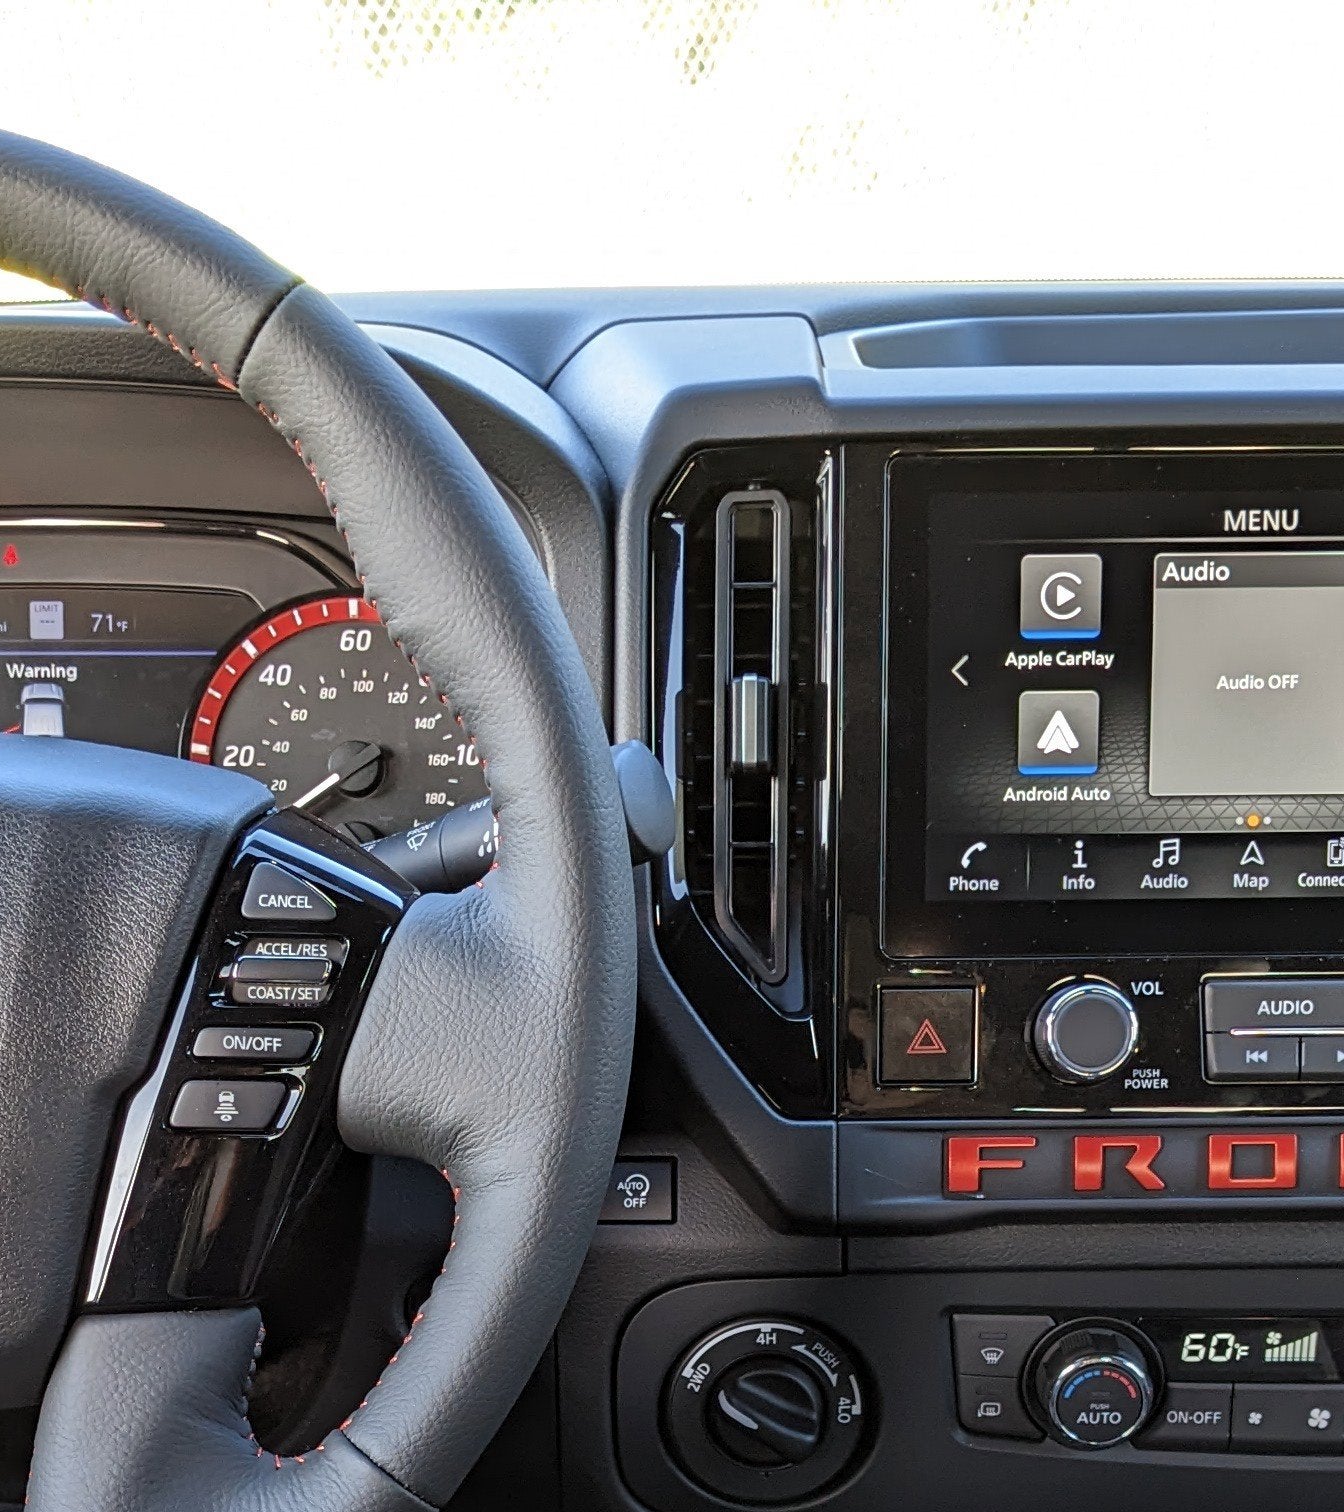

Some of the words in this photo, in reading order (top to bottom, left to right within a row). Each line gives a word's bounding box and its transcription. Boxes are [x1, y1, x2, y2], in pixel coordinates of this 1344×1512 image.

[1224, 510, 1299, 531] MENU
[1162, 562, 1230, 581] Audio
[34, 604, 59, 613] LIMIT
[339, 629, 372, 651] 60
[1005, 651, 1051, 670] Apple
[1056, 650, 1114, 670] CarPlay
[6, 663, 77, 682] Warning
[258, 664, 292, 686] 40
[352, 680, 374, 693] 100
[1217, 675, 1263, 690] Audio
[1267, 675, 1299, 690] OFF
[319, 687, 337, 700] 80
[387, 692, 408, 704] 120
[290, 709, 308, 722] 60
[414, 717, 436, 730] 140
[272, 741, 290, 753] 40
[222, 745, 255, 767] 20
[428, 753, 449, 766] 160
[270, 779, 287, 792] 20
[1003, 785, 1064, 801] Android
[1067, 785, 1111, 801] Auto
[425, 792, 447, 805] 180
[949, 875, 999, 892] Phone
[1062, 874, 1095, 890] Info
[1141, 874, 1188, 889] Audio
[1233, 873, 1269, 891] Map
[258, 893, 313, 909] CANCEL
[255, 942, 327, 957] ACCEL/RES
[247, 986, 321, 1001] COAST/SET
[1131, 981, 1164, 995] VOL
[1257, 999, 1314, 1016] AUDIO
[222, 1036, 282, 1052] ON/OFF
[1132, 1069, 1160, 1078] PUSH
[1125, 1079, 1169, 1089] POWER
[617, 1181, 644, 1191] AUTO
[623, 1198, 647, 1208] OFF
[756, 1333, 777, 1345] 4H
[811, 1342, 840, 1369] PUSH
[687, 1362, 711, 1393] 2WD
[837, 1396, 851, 1424] 4LO
[1077, 1412, 1122, 1425] AUTO
